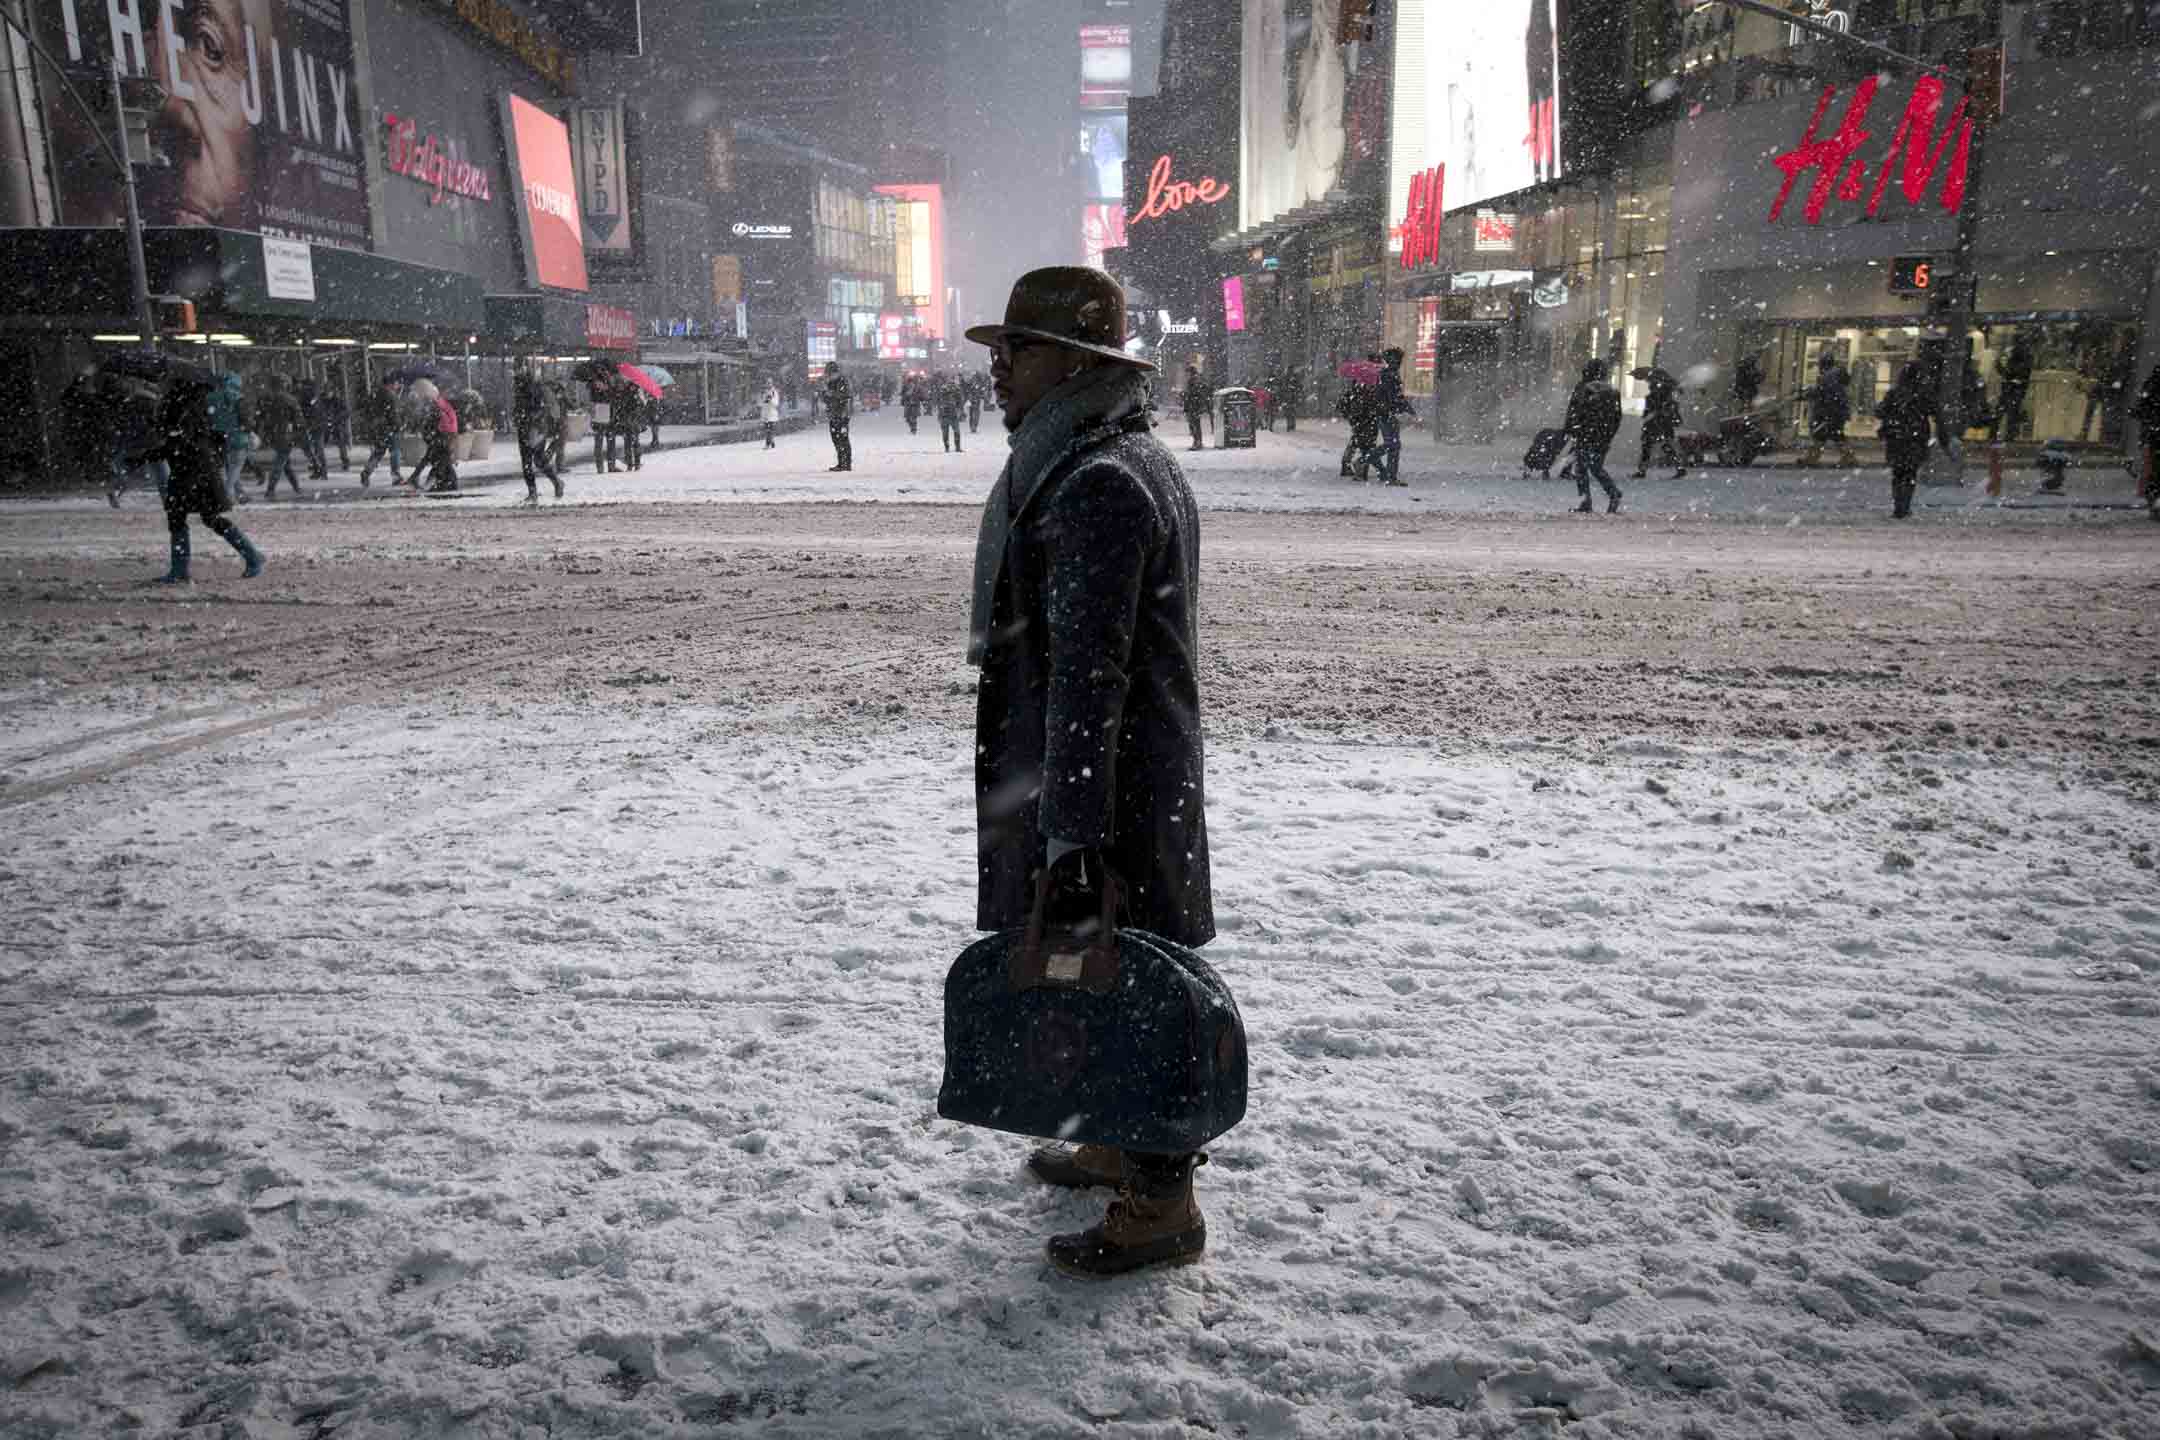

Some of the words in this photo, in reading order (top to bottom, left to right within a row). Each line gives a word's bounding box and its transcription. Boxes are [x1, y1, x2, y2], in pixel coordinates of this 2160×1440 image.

[61, 0, 193, 97] THE
[240, 24, 353, 152] JINX
[592, 111, 609, 213] NYPD
[1767, 65, 1976, 225] H&M
[1129, 154, 1231, 224] love
[749, 225, 792, 234] LEXUS
[1914, 264, 1930, 288] 6
[1161, 324, 1199, 334] CITIZEN
